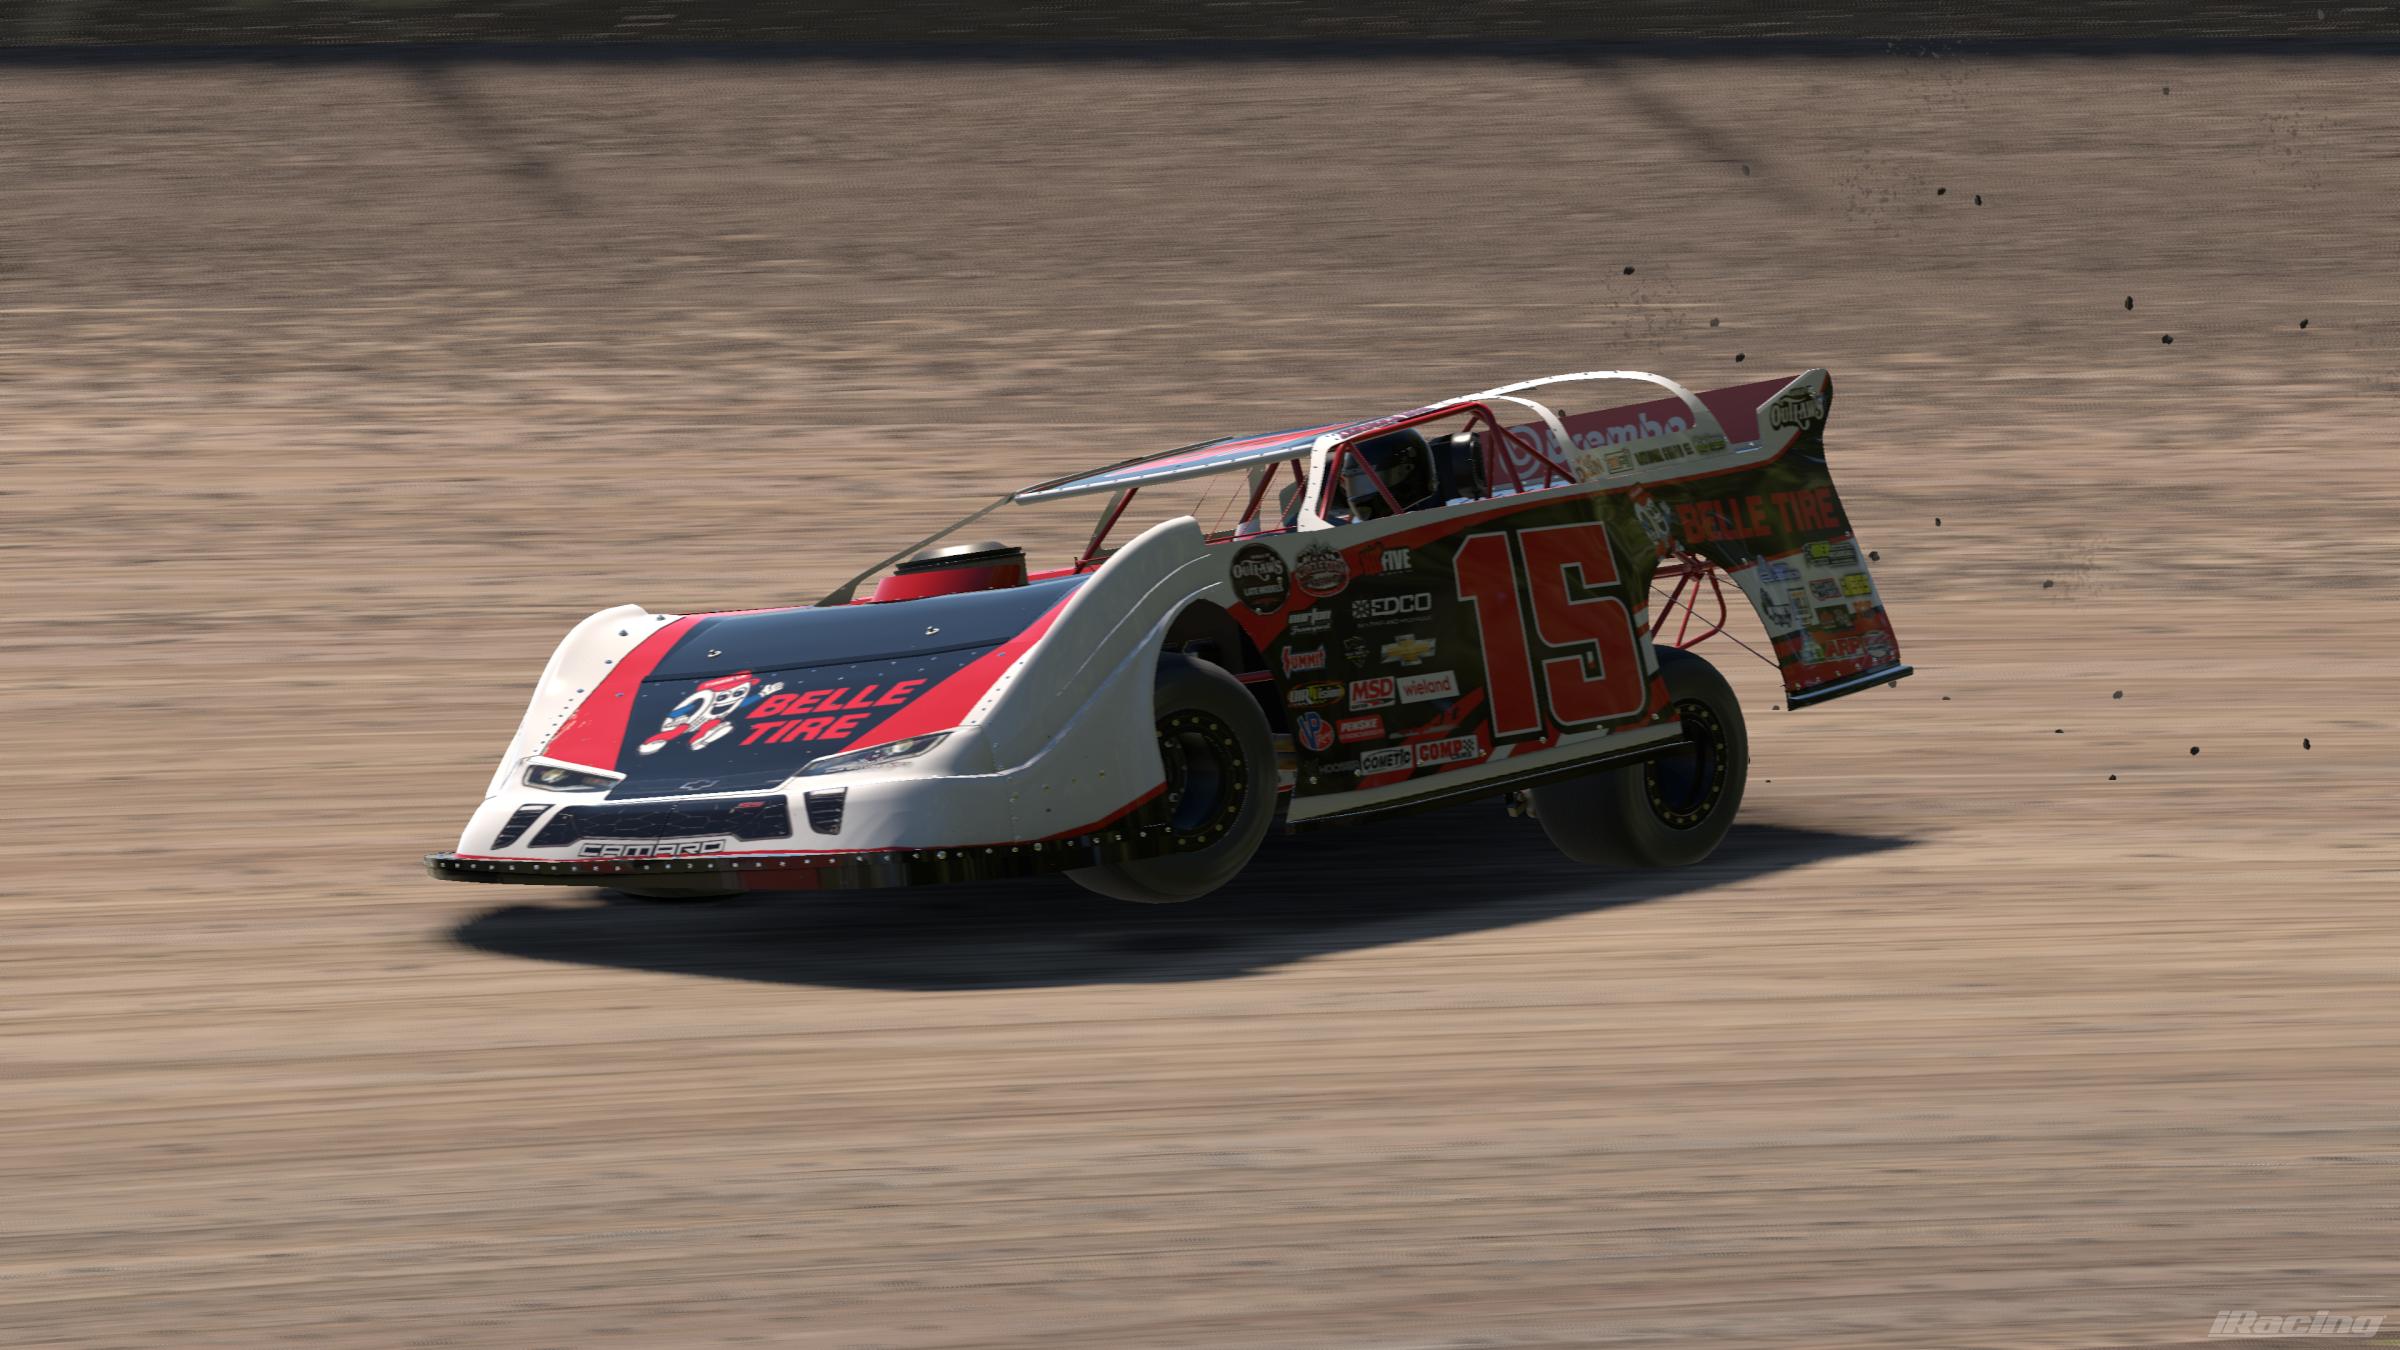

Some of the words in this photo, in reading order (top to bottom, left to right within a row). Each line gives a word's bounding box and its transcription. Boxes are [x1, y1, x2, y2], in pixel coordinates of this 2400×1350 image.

[1546, 412, 1687, 464] brembo
[1675, 495, 1772, 544] BELLE
[1771, 488, 1841, 532] TIRE
[1232, 557, 1284, 581] OUTLAWS
[1380, 548, 1412, 572] FIVE
[1371, 592, 1432, 617] EDCO
[1452, 521, 1645, 738] 15
[1282, 645, 1326, 675] SUMMIT
[1352, 678, 1393, 701] MSD
[1403, 675, 1451, 697] wieland
[745, 678, 928, 719] BELLE
[738, 713, 872, 746] TIRE
[1363, 749, 1411, 770] COMETIC
[1420, 740, 1462, 760] COMP
[578, 839, 727, 858] CAMARO
